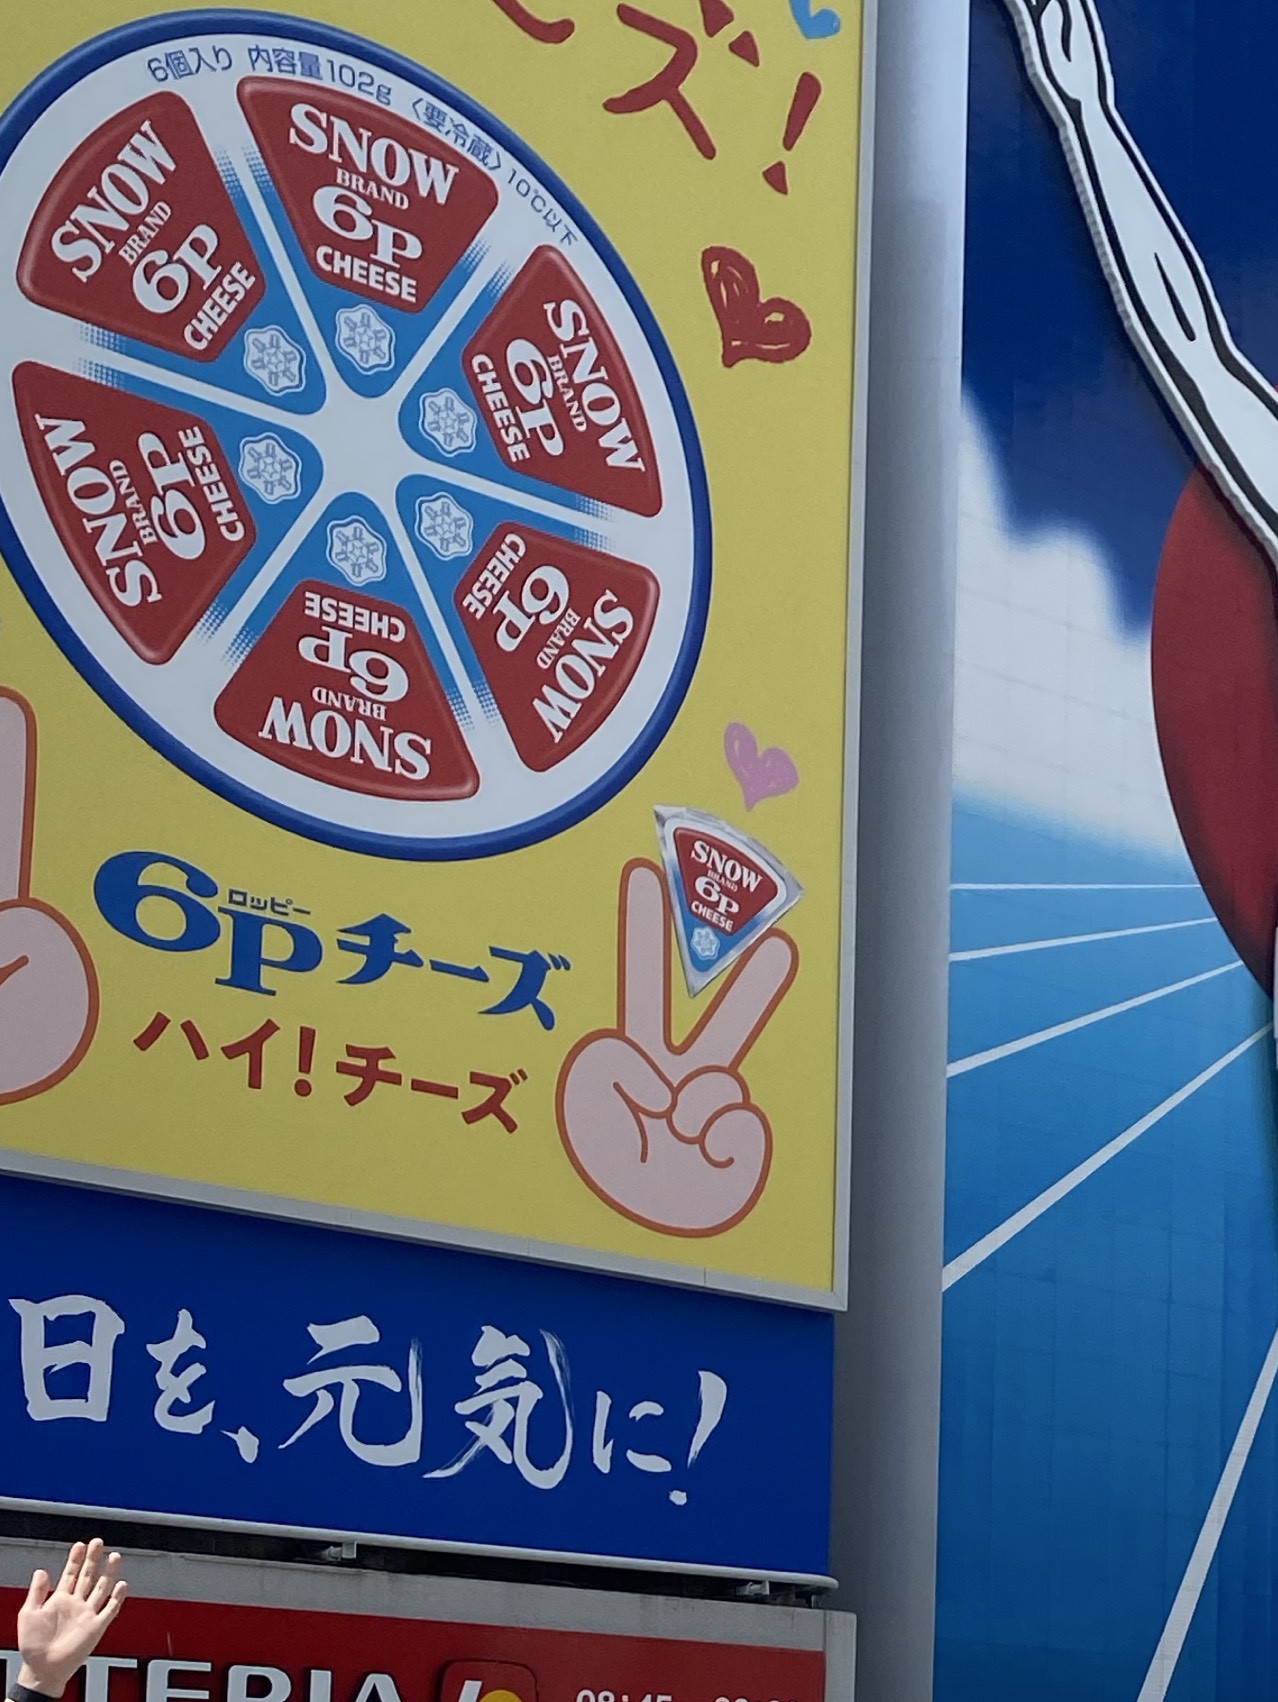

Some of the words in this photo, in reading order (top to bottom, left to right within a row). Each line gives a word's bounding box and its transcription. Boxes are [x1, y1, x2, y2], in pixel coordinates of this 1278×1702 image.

[146, 44, 234, 84] 6個入り
[248, 44, 392, 107] 内容量102g
[288, 102, 460, 206] SNOW
[336, 166, 410, 211] BRAND
[51, 119, 177, 283] SNOW
[118, 201, 172, 266] BRAND
[312, 184, 424, 269] 6P
[132, 224, 222, 314] 6P
[183, 261, 256, 350] CHEESE
[316, 245, 418, 304] CHEESE
[471, 353, 531, 463] CHEESE
[505, 338, 565, 457] 6P
[543, 299, 646, 472] SNOW
[547, 354, 587, 432] BRAND
[34, 413, 162, 607] SNOW
[108, 459, 158, 545] BRAND
[138, 432, 206, 561] 6P
[178, 426, 245, 542] CHEESE
[304, 591, 406, 643] CHEESE
[462, 533, 526, 620] CHEESE
[493, 565, 570, 653] 6P
[298, 625, 409, 702] 6P
[532, 589, 634, 744] SNOW
[536, 608, 581, 669] BRAND
[258, 696, 432, 781] SNOW
[311, 686, 387, 721] BRAND
[228, 888, 311, 917] ロッピー
[690, 840, 763, 893] SNOW
[694, 875, 740, 916] 6P
[691, 900, 734, 933] CHEESE
